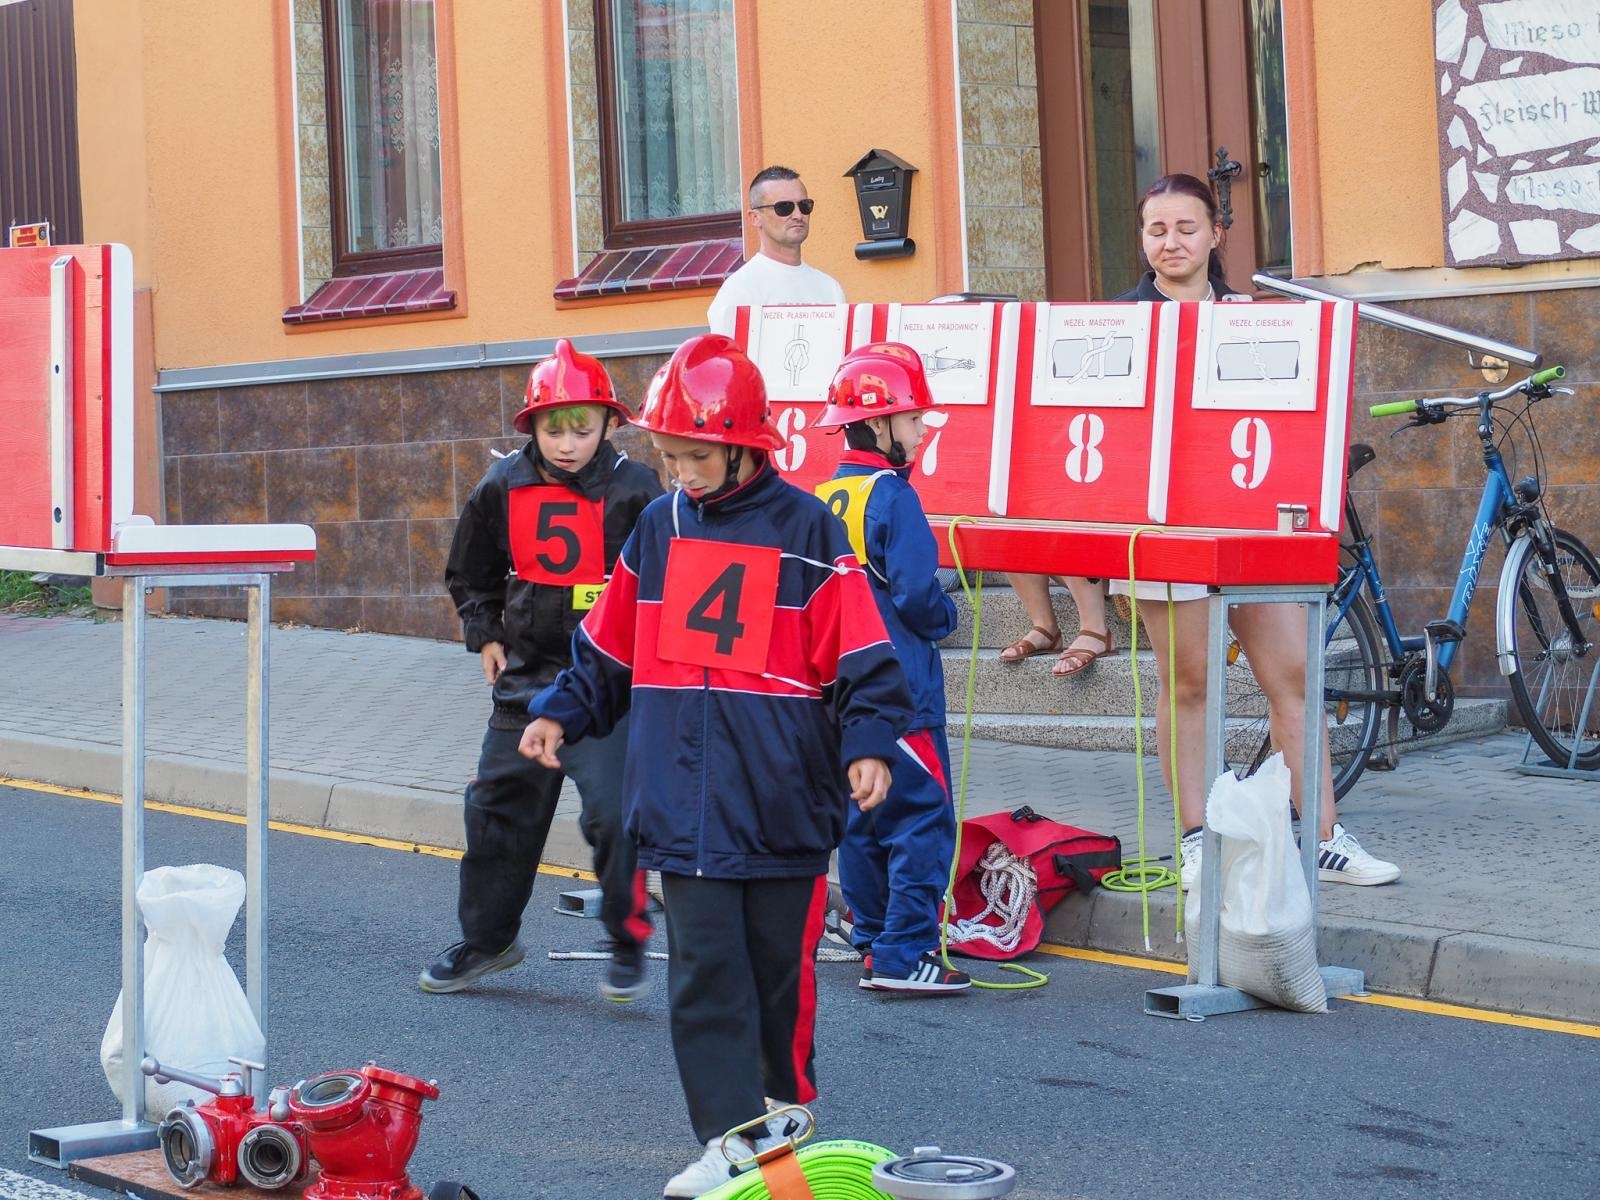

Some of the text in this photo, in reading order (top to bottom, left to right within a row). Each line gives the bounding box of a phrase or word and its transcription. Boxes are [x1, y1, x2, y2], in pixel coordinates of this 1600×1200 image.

[926, 323, 936, 331] NA
[1088, 318, 1126, 327] MASZTOWY
[1255, 318, 1294, 327] CIESIELSKI
[774, 407, 807, 472] 6
[921, 410, 949, 476] 7
[1065, 413, 1105, 483] 8
[1230, 417, 1272, 490] 9
[535, 501, 582, 575] 5
[686, 562, 746, 656] 4
